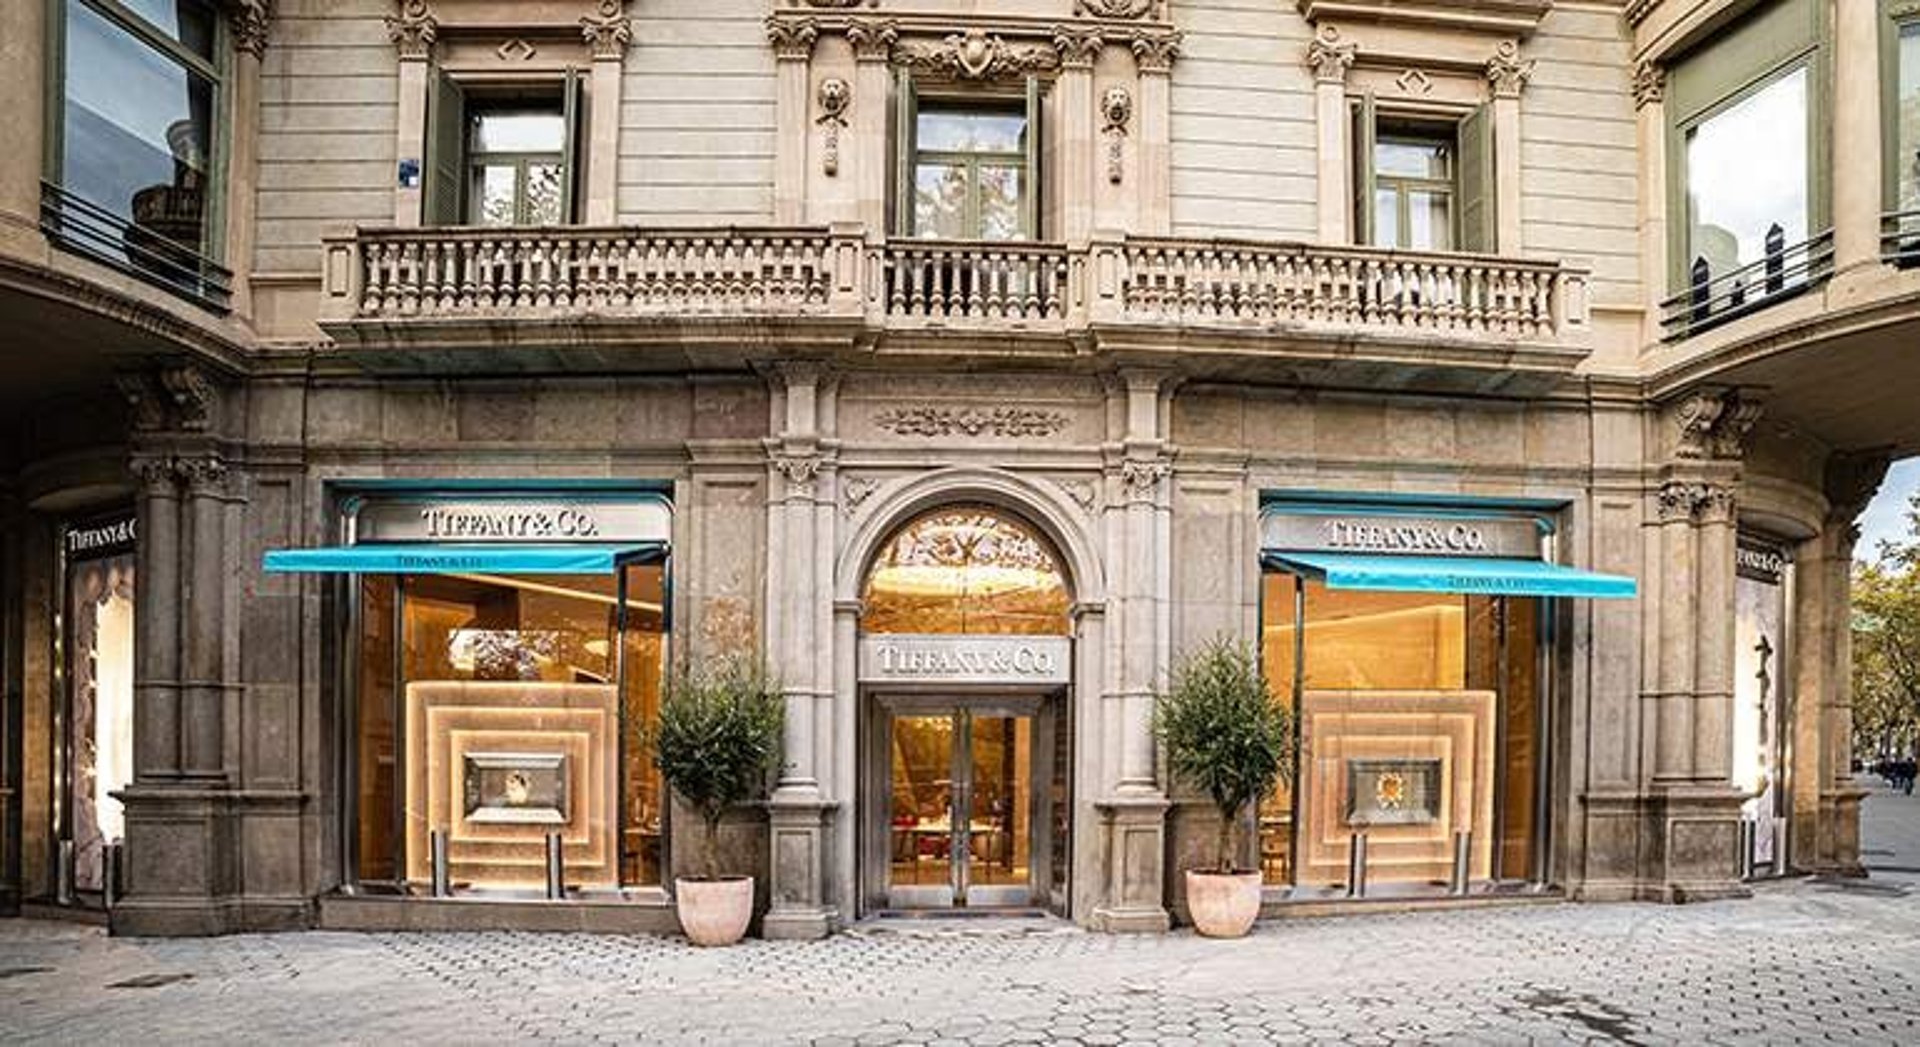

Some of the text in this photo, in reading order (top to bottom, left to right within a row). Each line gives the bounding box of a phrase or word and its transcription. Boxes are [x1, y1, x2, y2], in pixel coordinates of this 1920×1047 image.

[421, 508, 531, 537] TIFFANY
[532, 511, 552, 536] &
[1324, 520, 1422, 550] TIFFANY
[877, 645, 984, 675] TIFFANY
[988, 648, 1010, 675] &
